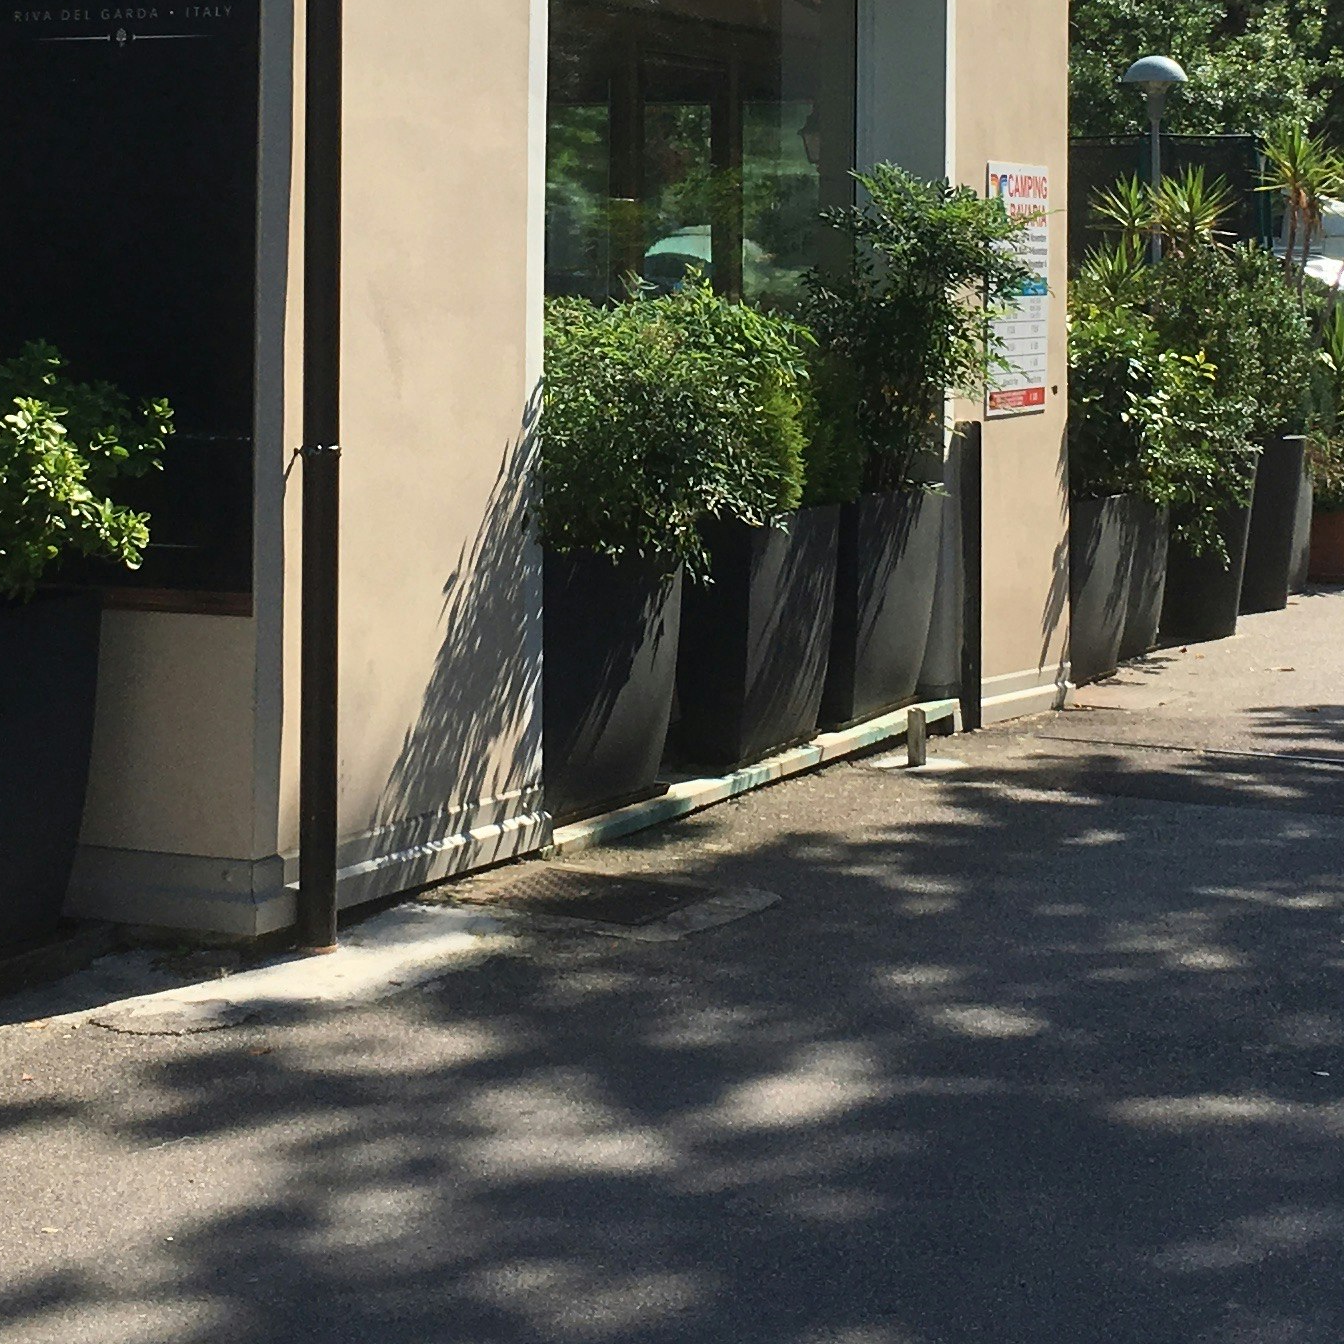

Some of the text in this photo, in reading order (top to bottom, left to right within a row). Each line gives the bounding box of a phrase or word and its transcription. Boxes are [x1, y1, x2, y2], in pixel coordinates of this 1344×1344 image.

[14, 5, 233, 23] RIVA DEL GARDA ITALY
[1008, 174, 1048, 199] CAMPING
